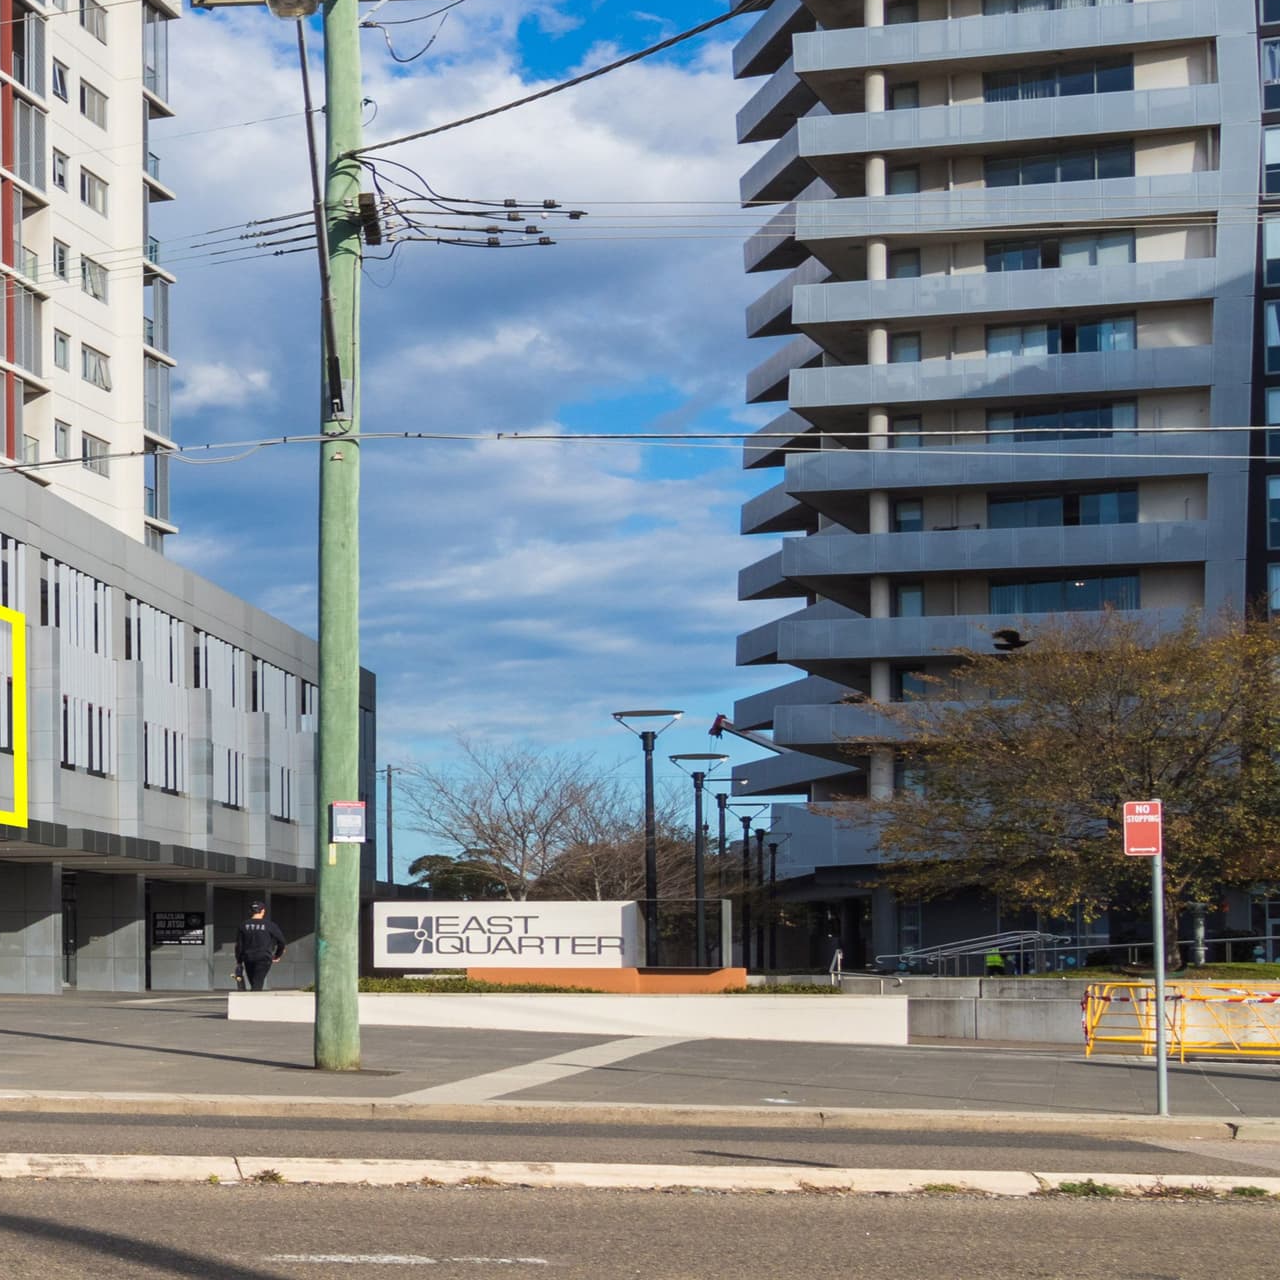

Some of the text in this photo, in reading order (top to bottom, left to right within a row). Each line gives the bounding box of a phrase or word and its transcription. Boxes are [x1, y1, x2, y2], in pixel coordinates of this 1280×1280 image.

[1135, 804, 1150, 814] NO
[1126, 815, 1160, 823] STOPPING
[435, 915, 539, 935] EAST
[435, 935, 625, 956] QUARTER
